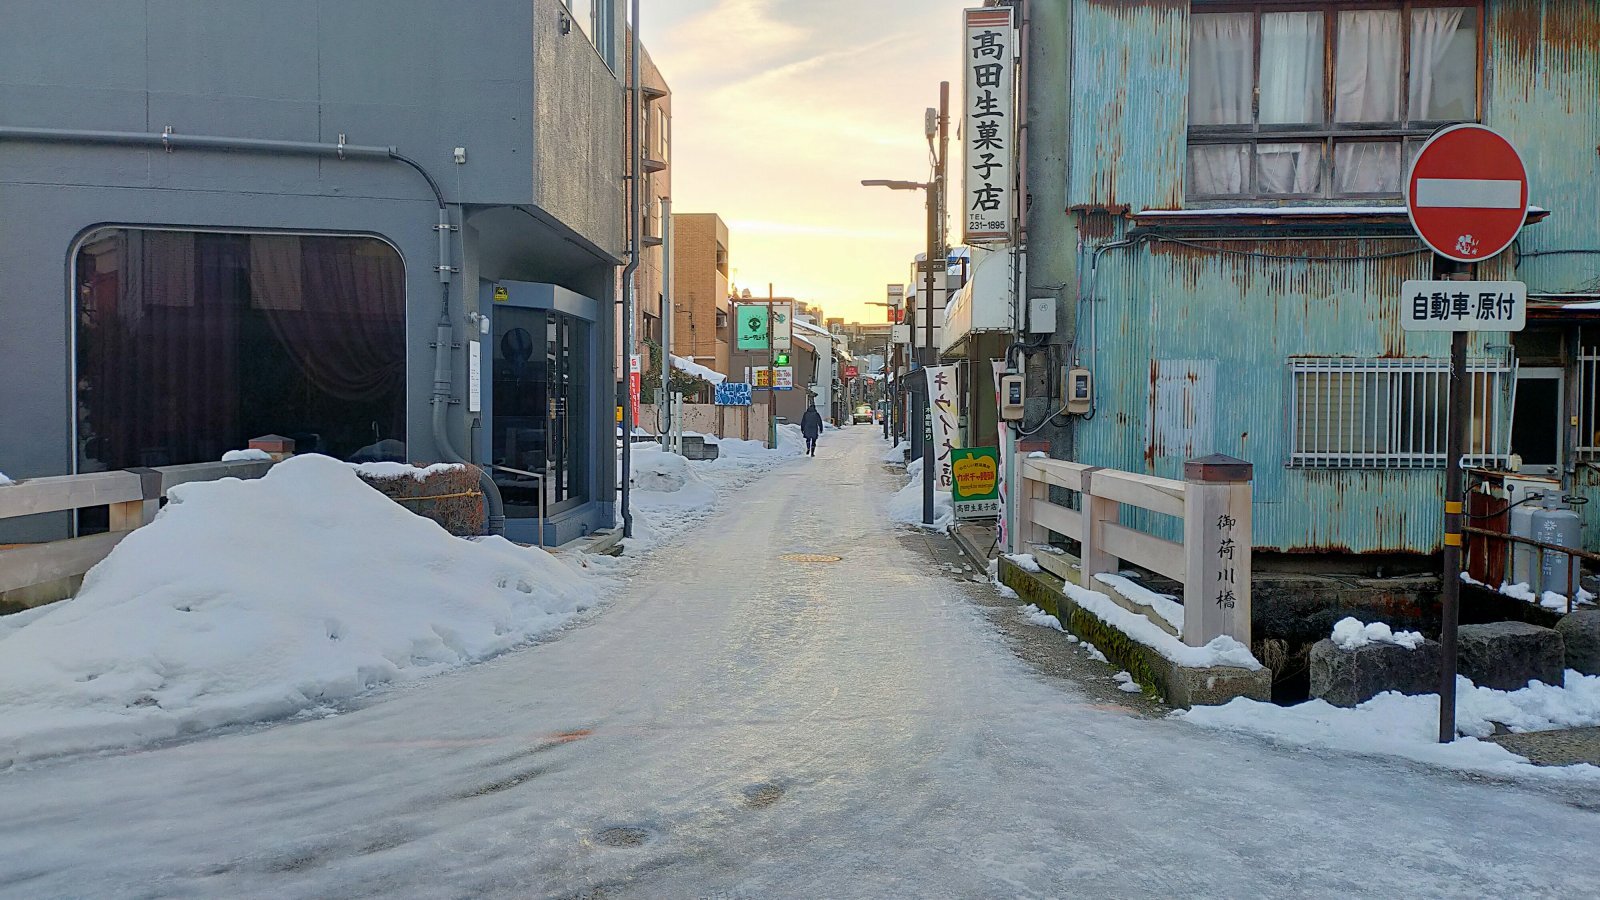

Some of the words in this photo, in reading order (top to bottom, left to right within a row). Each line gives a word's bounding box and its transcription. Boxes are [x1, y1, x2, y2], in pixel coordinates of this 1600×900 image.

[969, 221, 1006, 230] 231-1895
[957, 471, 995, 482] カボチャ饅頭
[1216, 514, 1237, 610] 御荷川橋
